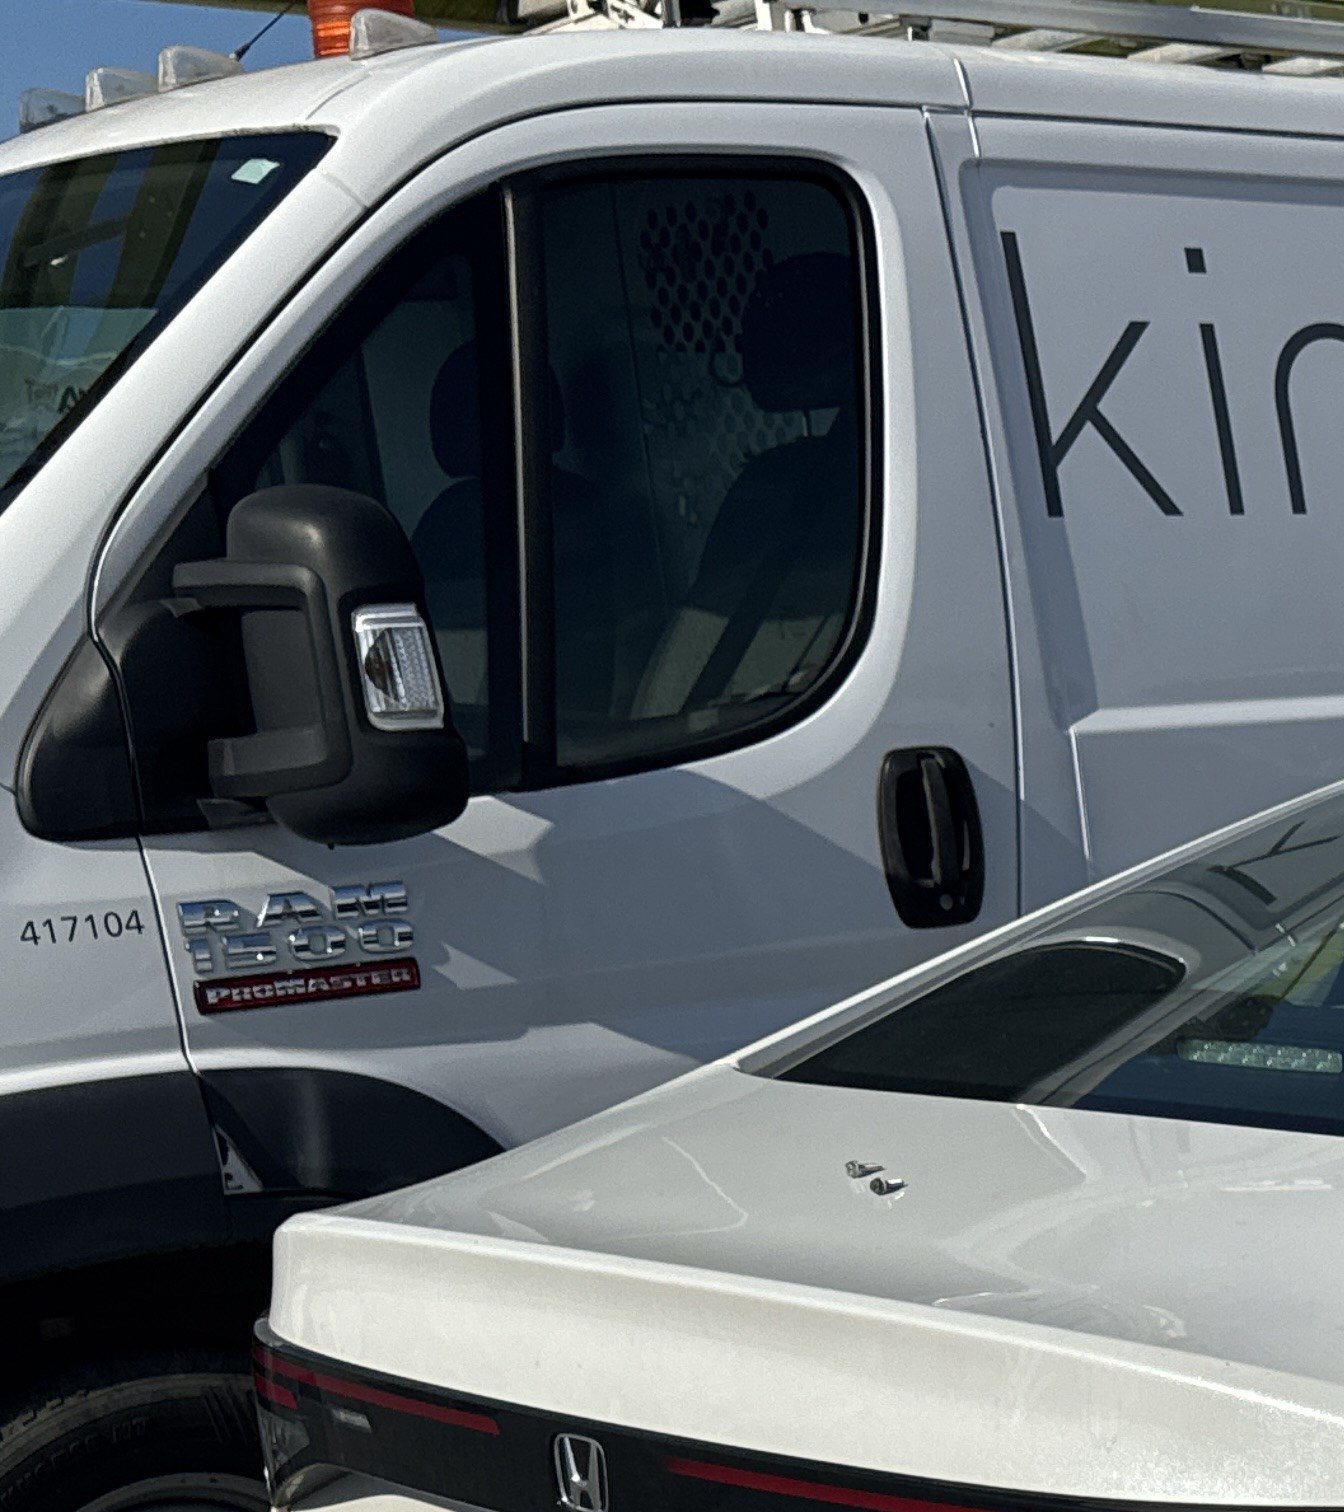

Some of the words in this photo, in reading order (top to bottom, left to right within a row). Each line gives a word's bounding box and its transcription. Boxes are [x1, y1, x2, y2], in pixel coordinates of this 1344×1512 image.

[20, 910, 145, 945] 417104
[178, 880, 408, 935] RAM
[184, 918, 414, 974] 1500
